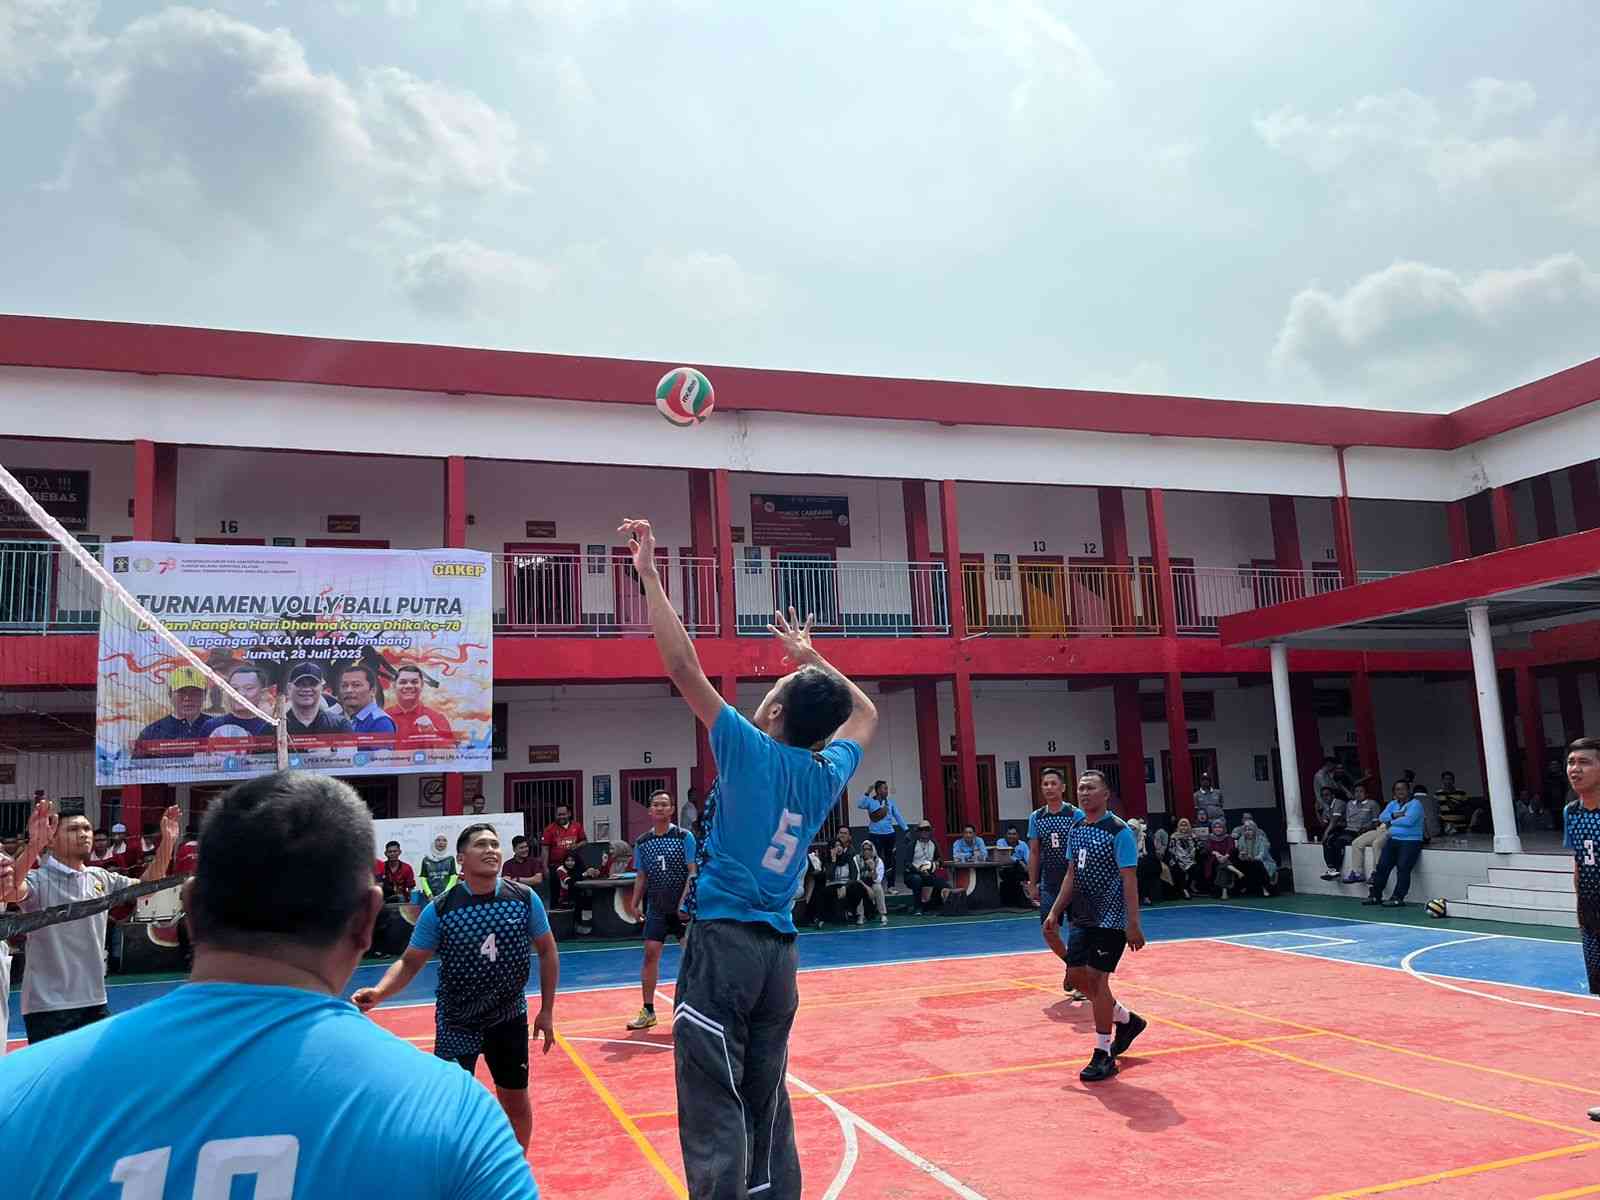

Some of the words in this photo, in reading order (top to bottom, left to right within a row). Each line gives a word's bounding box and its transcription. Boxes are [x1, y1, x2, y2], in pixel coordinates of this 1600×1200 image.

[220, 520, 238, 533] 16
[1034, 541, 1046, 552] 13
[1083, 543, 1097, 554] 12
[137, 594, 265, 614] TURNAMEN
[271, 595, 341, 614] VOLLY
[342, 596, 391, 614] BALL
[397, 597, 463, 615] PUTRA
[191, 620, 247, 634] Rangka
[249, 620, 280, 631] Hari
[281, 620, 337, 631] Dharma
[340, 620, 381, 634] Karya
[383, 620, 421, 631] Dhika
[423, 620, 461, 631] ke-78
[190, 636, 258, 649] Lapangan
[260, 636, 292, 646] LPKA
[294, 635, 330, 646] Kelas
[338, 635, 411, 649] Palembang
[243, 649, 289, 660] Jumat,
[291, 650, 306, 660] 28
[307, 649, 331, 660] Juli
[332, 649, 362, 660] 2023
[1048, 741, 1057, 752] 8
[643, 752, 652, 764] 6
[761, 808, 803, 875] 5
[1051, 832, 1060, 848] 6
[1583, 840, 1595, 865] 3
[480, 933, 498, 962] 4
